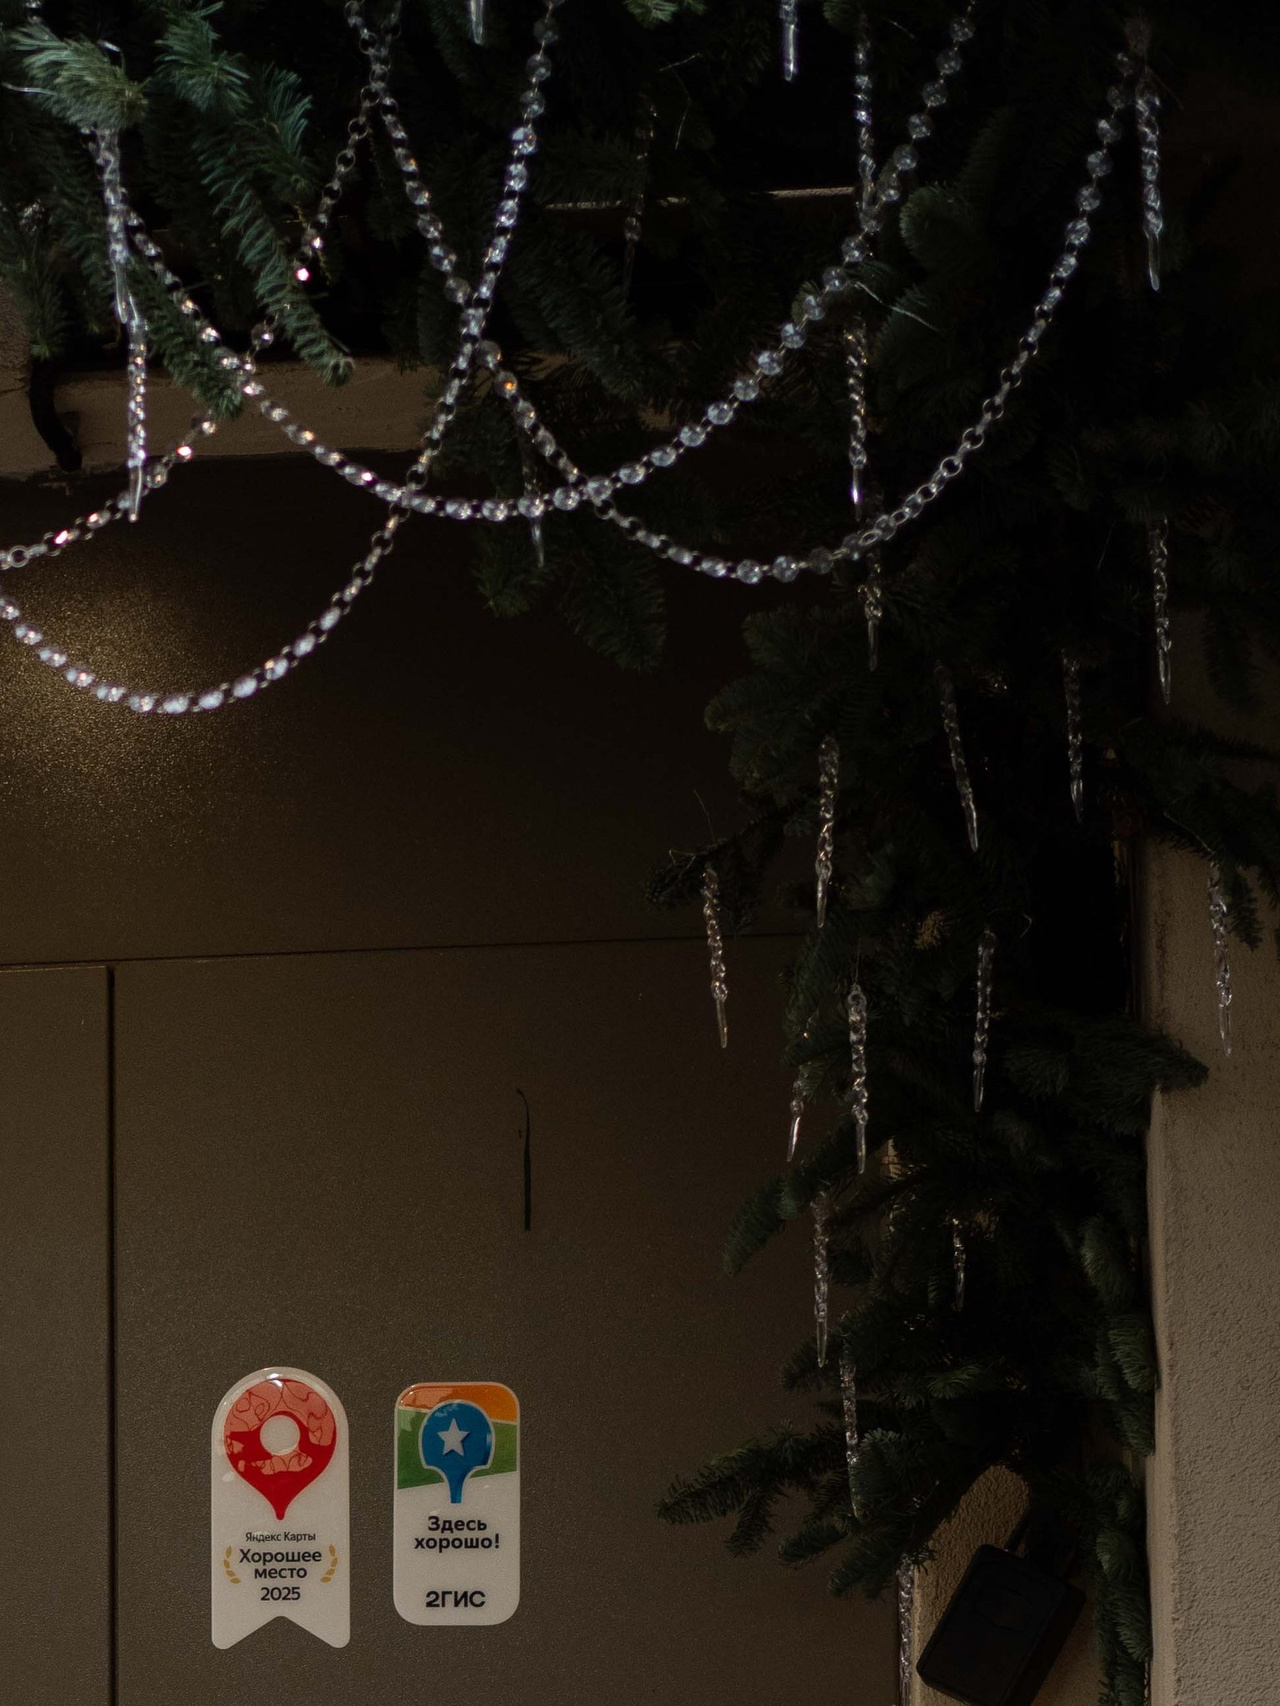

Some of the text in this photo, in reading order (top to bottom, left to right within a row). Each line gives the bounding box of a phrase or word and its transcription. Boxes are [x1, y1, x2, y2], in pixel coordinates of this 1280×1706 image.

[428, 1515, 487, 1534] Здесь
[245, 1531, 316, 1543] Яндекс Карты
[414, 1534, 500, 1553] хорошо!
[239, 1549, 322, 1567] Хорошее
[254, 1565, 307, 1579] место
[260, 1586, 301, 1601] 2025
[425, 1590, 486, 1608] 2ГИС
